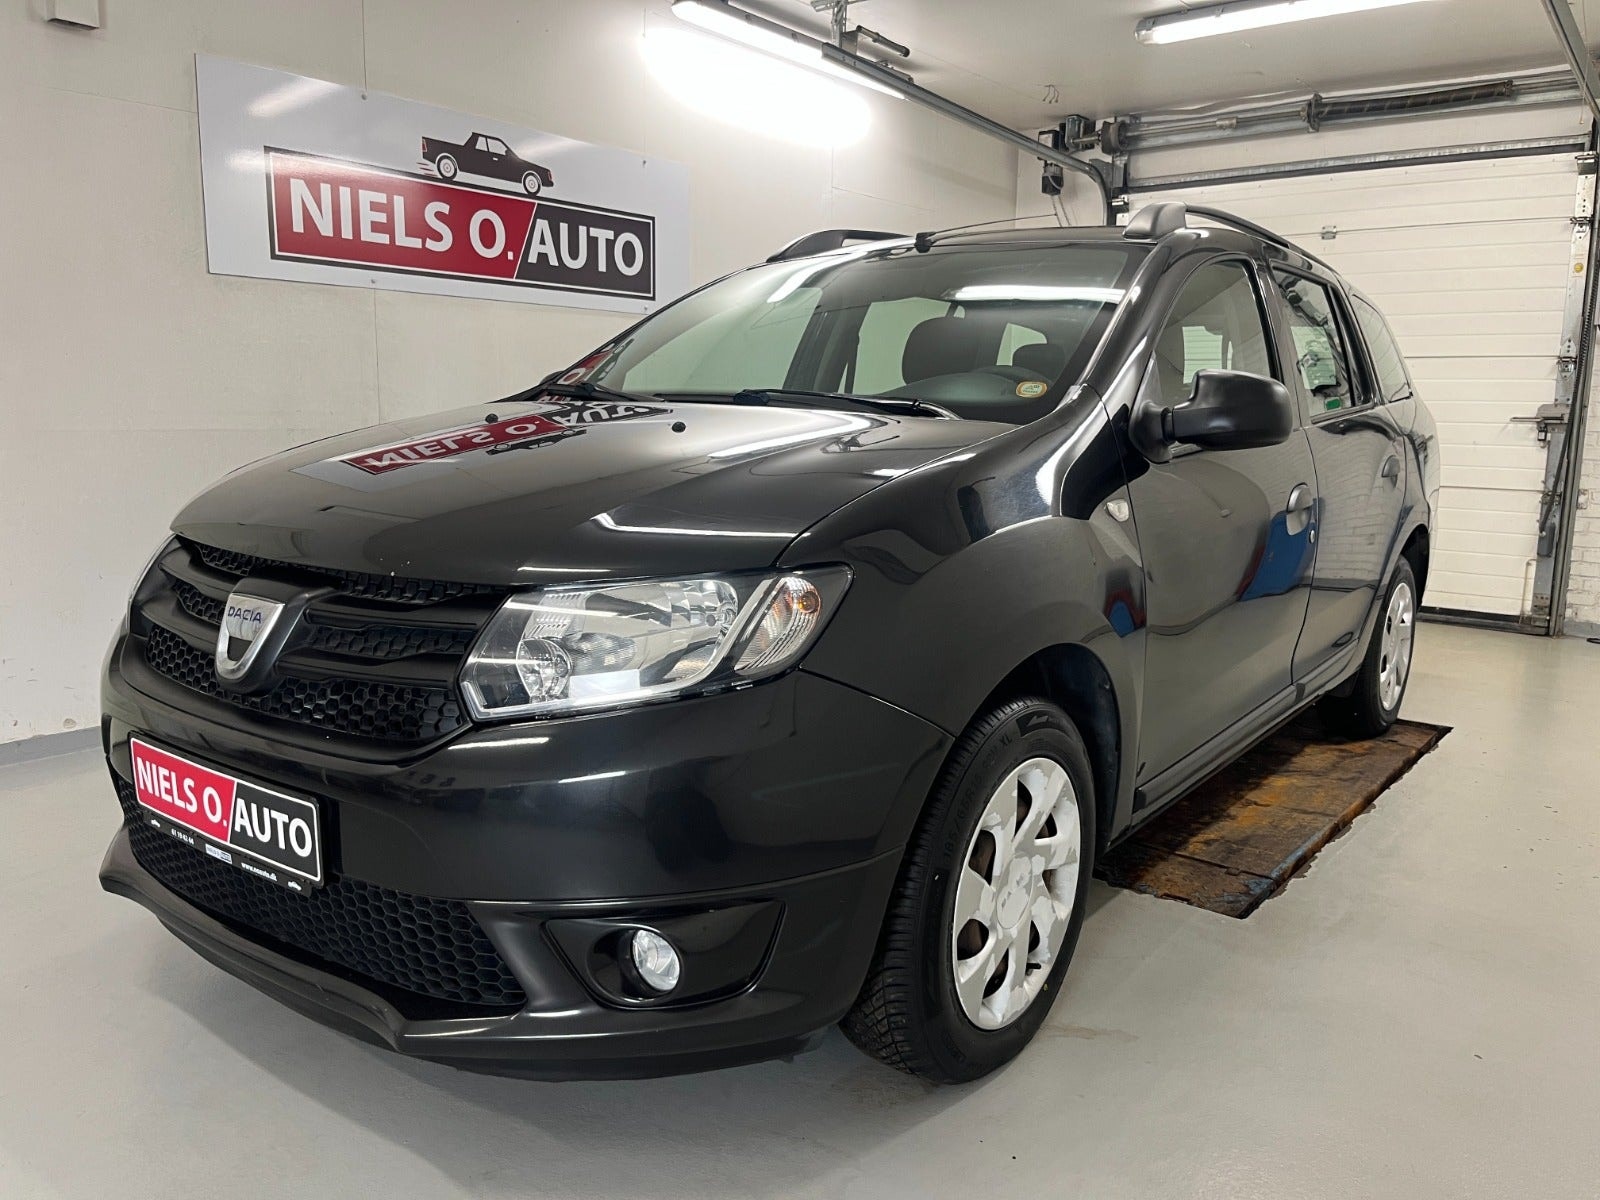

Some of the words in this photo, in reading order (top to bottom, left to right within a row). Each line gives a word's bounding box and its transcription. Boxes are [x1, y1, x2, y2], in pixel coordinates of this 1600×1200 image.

[291, 179, 454, 253] NIELS
[470, 209, 514, 261] O.
[527, 218, 644, 276] AUTO
[228, 606, 262, 623] DACIA
[136, 756, 198, 814] NIELS
[203, 786, 228, 827] O.
[234, 797, 313, 858] AUTO
